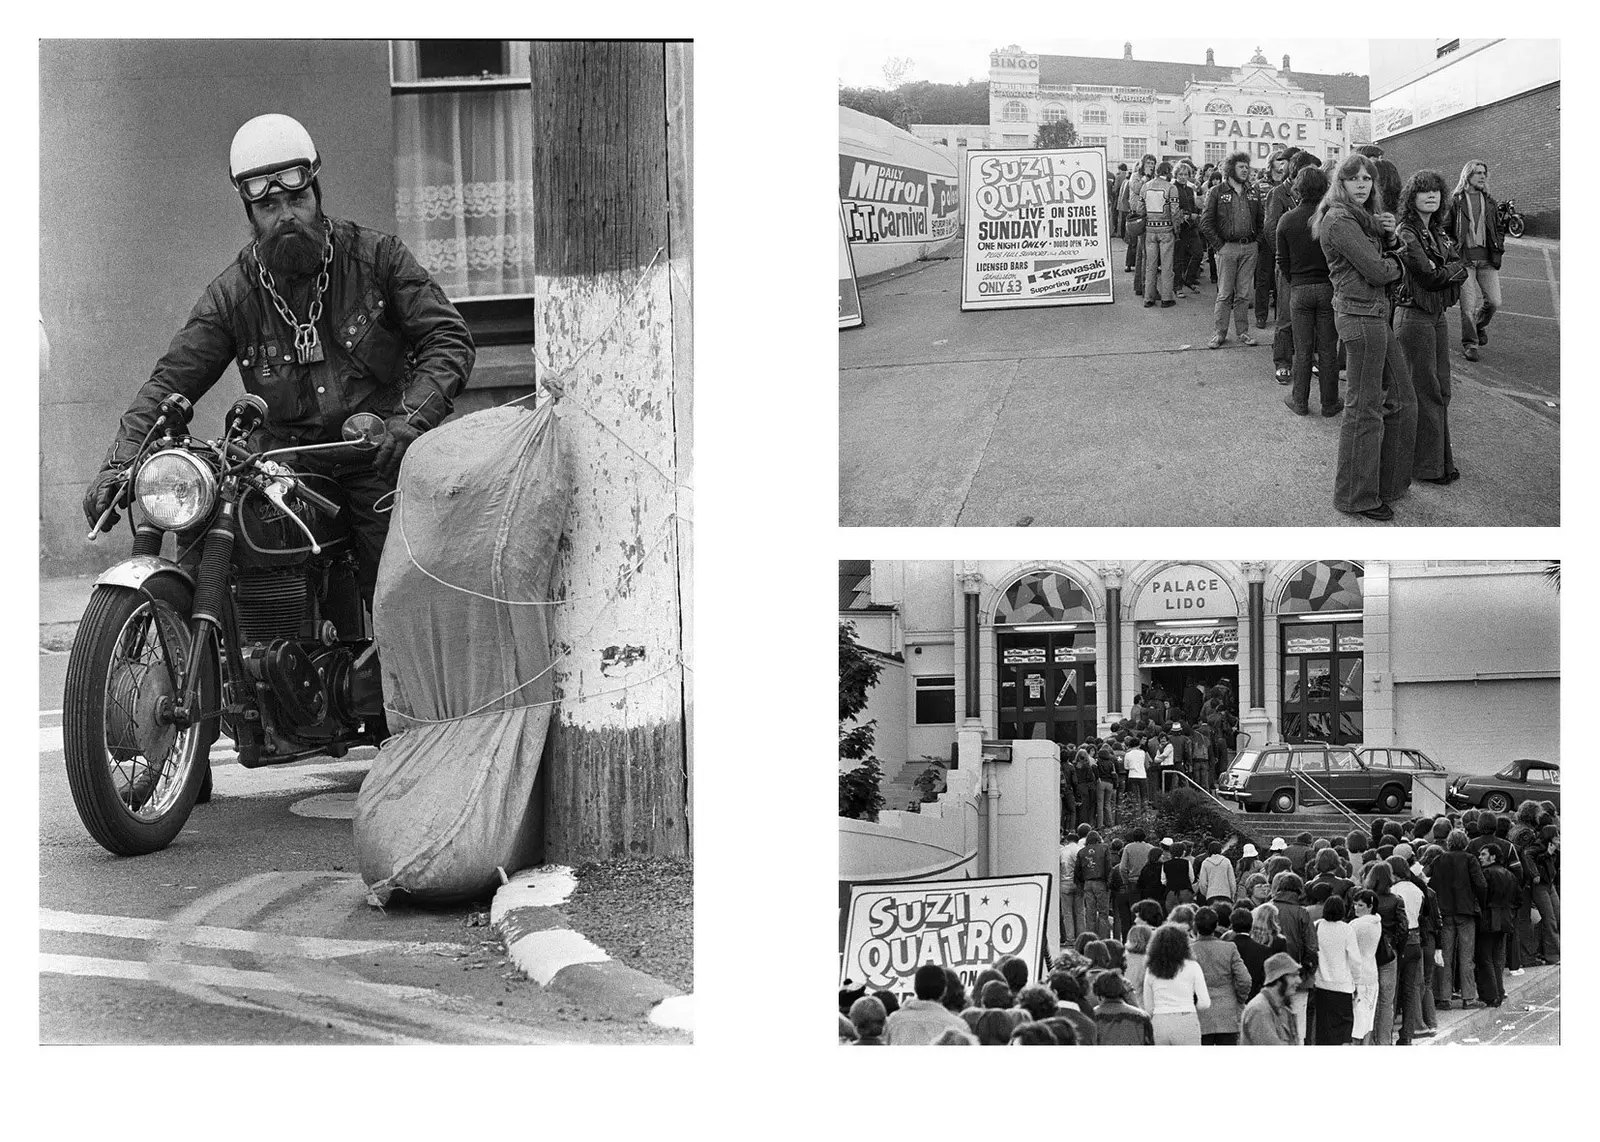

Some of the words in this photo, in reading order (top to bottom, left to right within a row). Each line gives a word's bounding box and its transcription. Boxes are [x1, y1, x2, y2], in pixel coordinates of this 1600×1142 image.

[991, 57, 1038, 70] BINGO
[1214, 119, 1307, 140] PALACE
[879, 166, 904, 180] DAILY
[981, 156, 1055, 185] SUZI
[848, 161, 925, 204] Mirror
[976, 170, 1096, 220] QUATRO
[1019, 207, 1045, 220] LIVE
[1051, 206, 1065, 218] ON
[1067, 205, 1097, 218] STAGE
[877, 206, 928, 239] Carnival
[978, 220, 1042, 241] SUNDAY
[1064, 218, 1098, 238] JUNE
[977, 242, 995, 251] ONE
[997, 241, 1020, 250] NIGHT
[1021, 240, 1048, 249] ONLY
[1053, 240, 1069, 248] DOORS
[1070, 240, 1082, 248] OPEN
[976, 262, 1008, 272] LICENSED
[1010, 261, 1029, 271] BARS
[1052, 258, 1105, 278] Kawasaki
[978, 281, 1005, 293] ONLY
[1006, 280, 1022, 293] £3
[1030, 280, 1070, 294] Supporting
[1152, 579, 1218, 593] PALACE
[1166, 597, 1206, 610] LIDO
[1138, 629, 1224, 646] Motorcycle
[1138, 644, 1238, 664] RACING
[869, 892, 970, 938] SUZI
[858, 913, 1028, 990] QUATRO
[960, 970, 978, 987] ON
